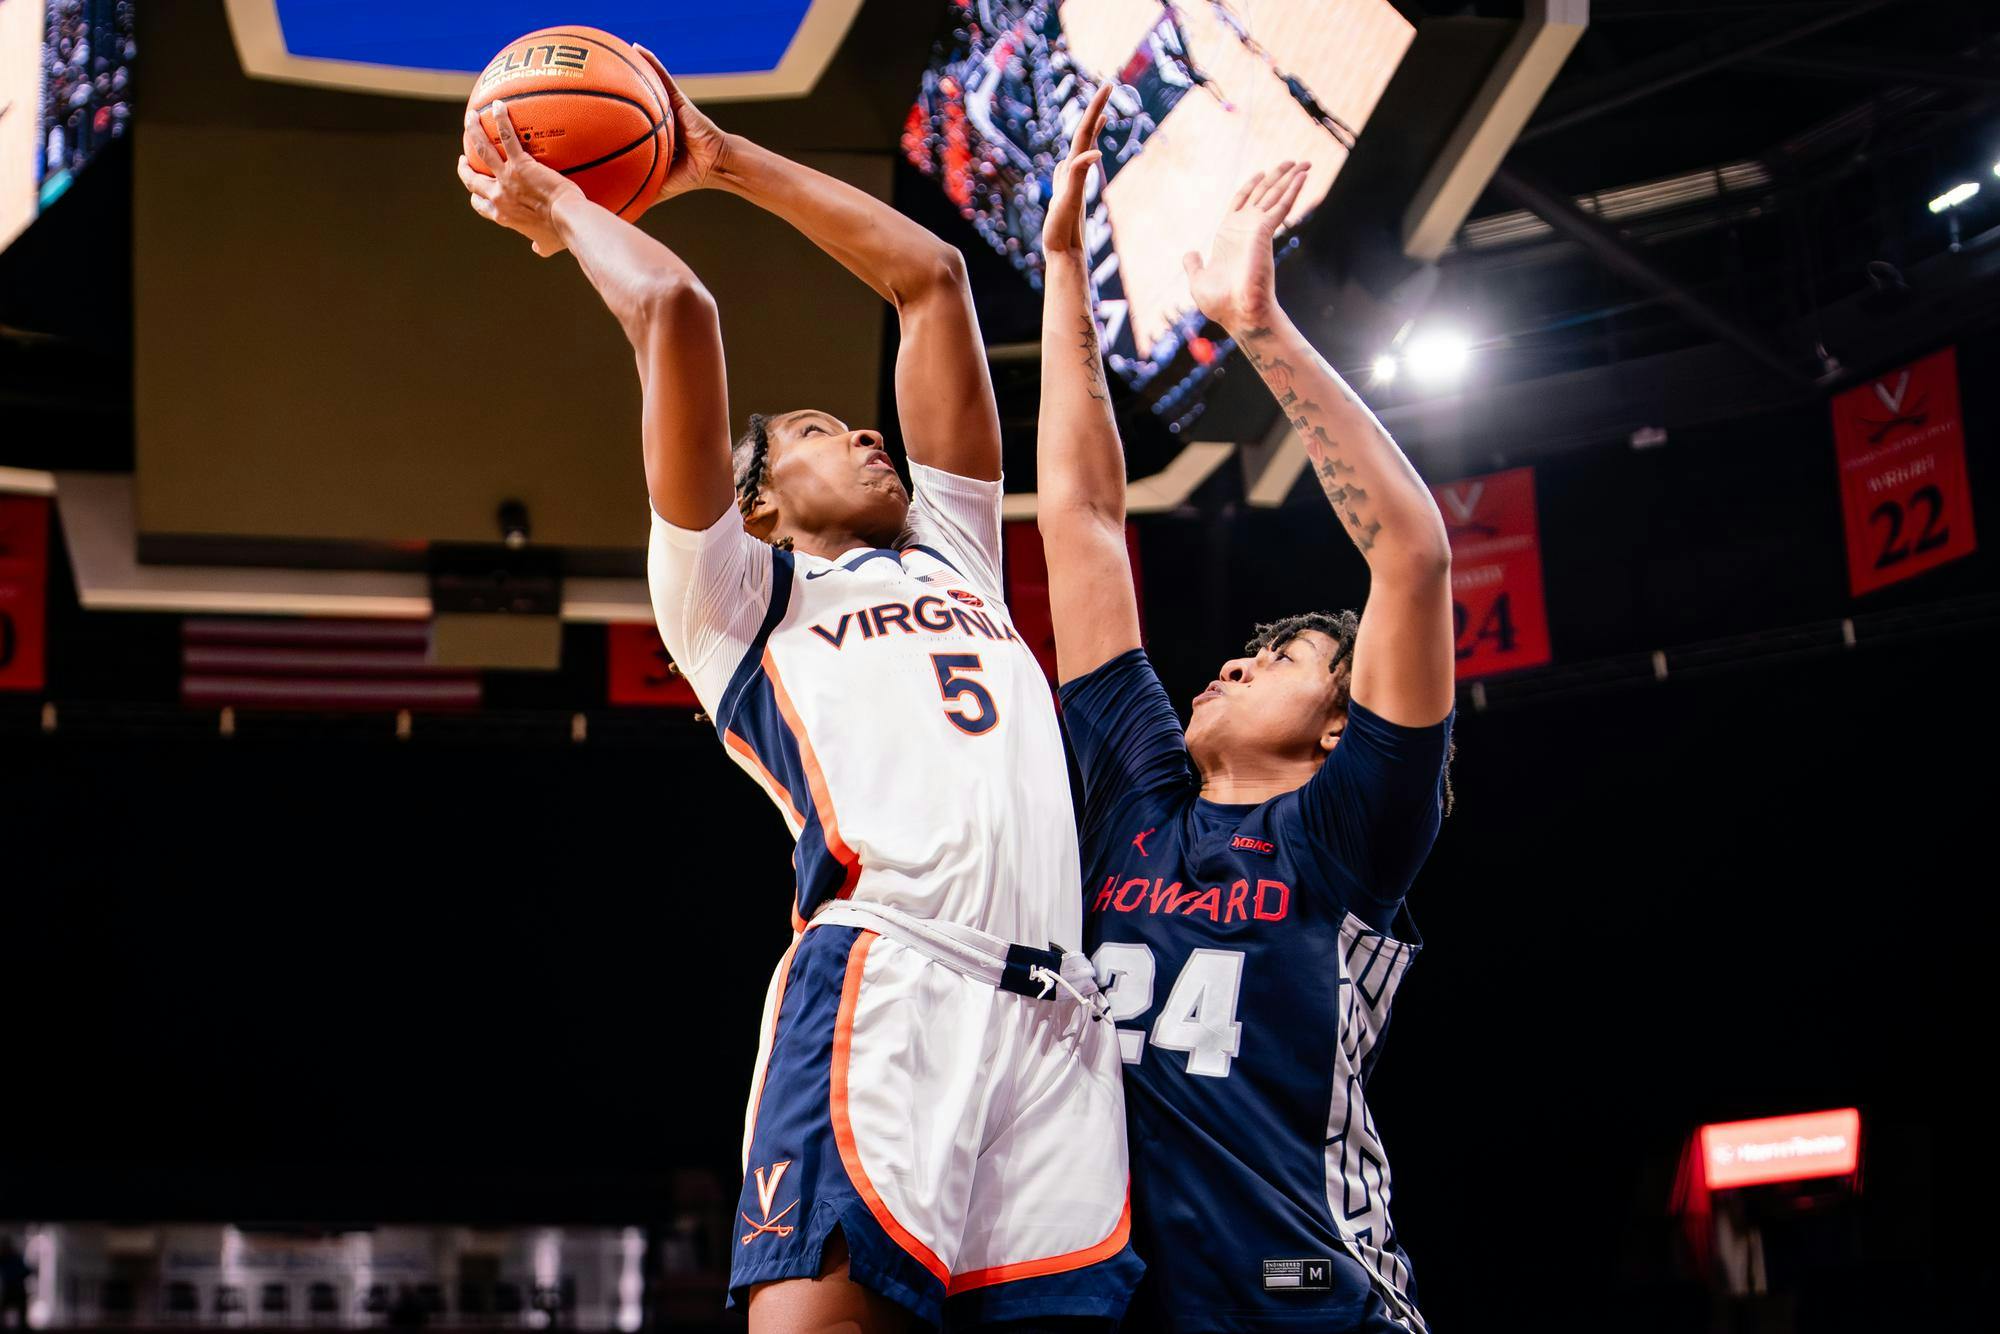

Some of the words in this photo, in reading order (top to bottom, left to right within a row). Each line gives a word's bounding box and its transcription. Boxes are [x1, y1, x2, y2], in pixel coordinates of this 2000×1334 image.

[1869, 484, 1950, 570] 22
[929, 652, 1000, 736] 5
[1231, 836, 1274, 853] MEAC
[1091, 872, 1292, 924] HOWARD
[1090, 941, 1246, 1078] 24
[1309, 1267, 1322, 1280] M
